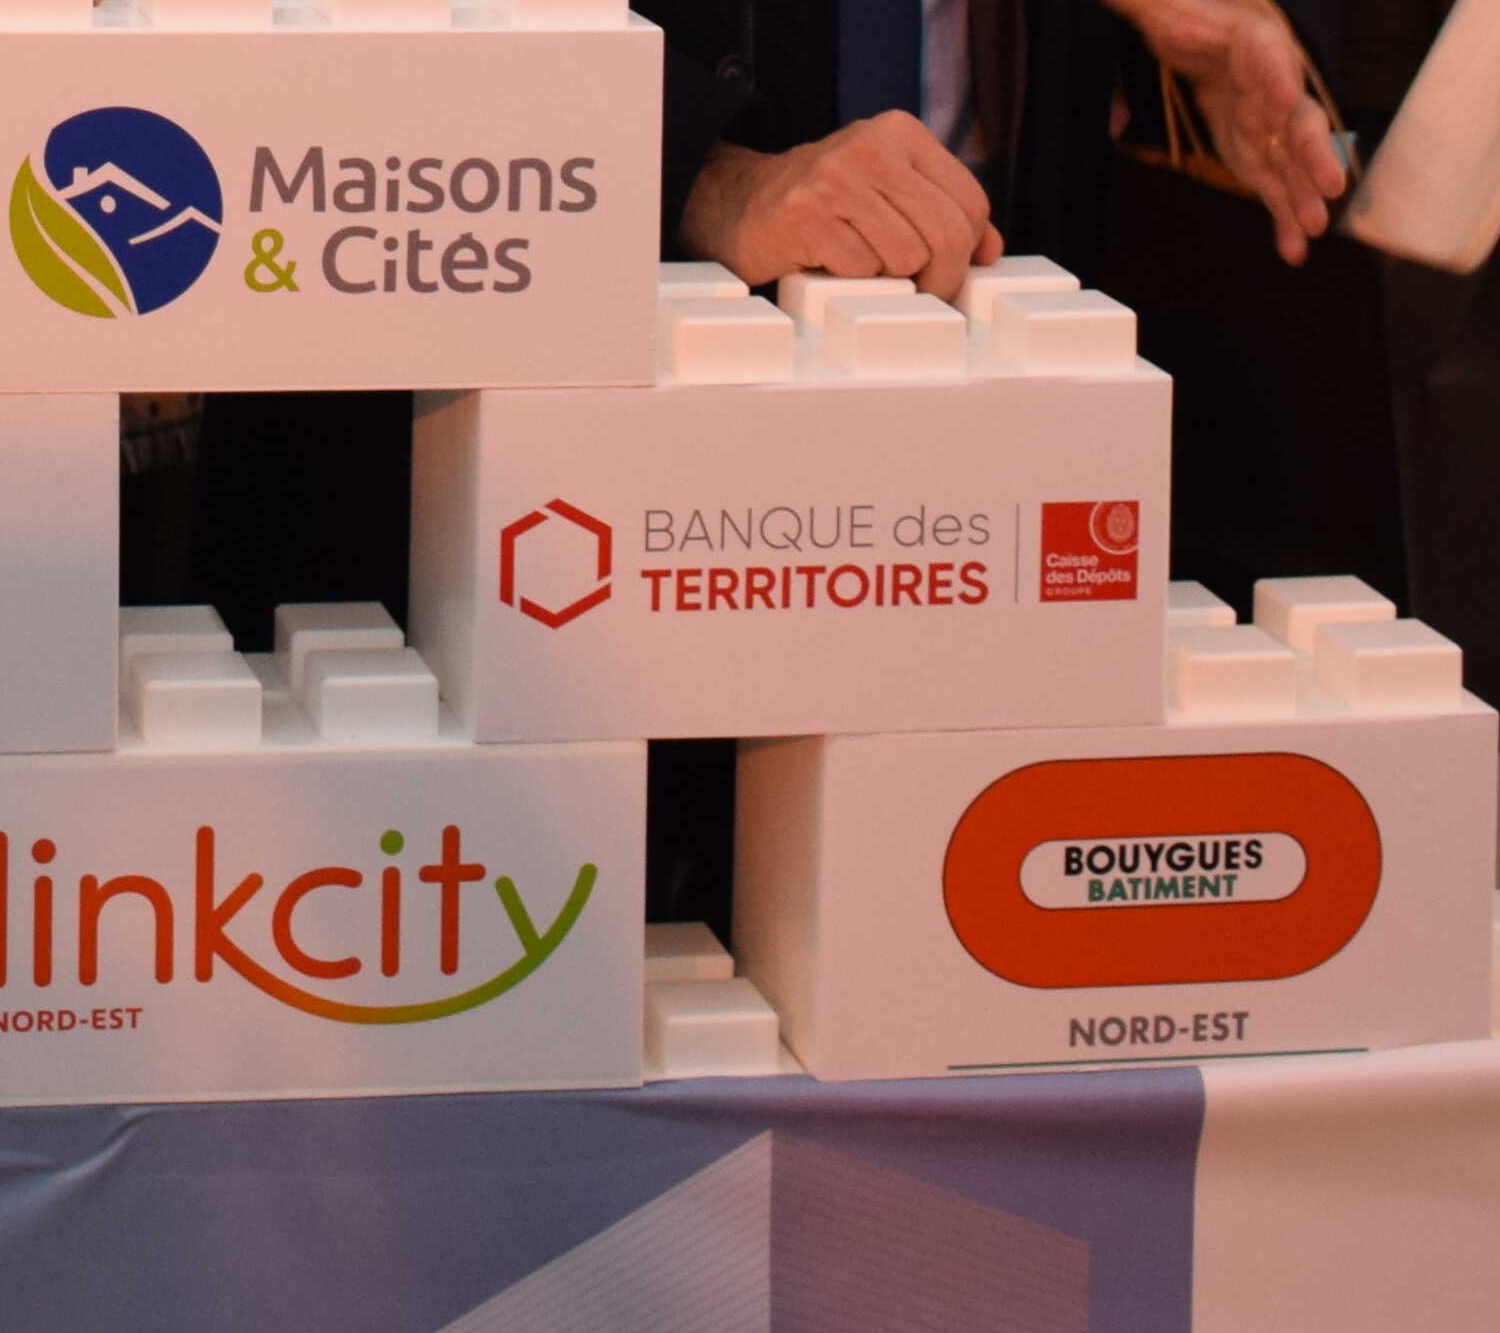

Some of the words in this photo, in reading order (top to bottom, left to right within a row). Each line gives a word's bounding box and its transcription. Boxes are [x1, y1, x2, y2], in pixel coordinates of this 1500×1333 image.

[249, 145, 598, 214] Maisons
[243, 227, 299, 293] &
[322, 224, 533, 294] Cités
[645, 504, 876, 553] BANQUE
[892, 503, 990, 547] des
[1046, 552, 1099, 567] Caisse
[1046, 569, 1074, 584] des
[1076, 568, 1131, 585] Dépôts
[641, 561, 990, 613] TERRITOIRES
[1063, 837, 1264, 877] BOUYGUES
[1087, 874, 1239, 903] BATIMENT
[1068, 1011, 1251, 1049] NORD-EST
